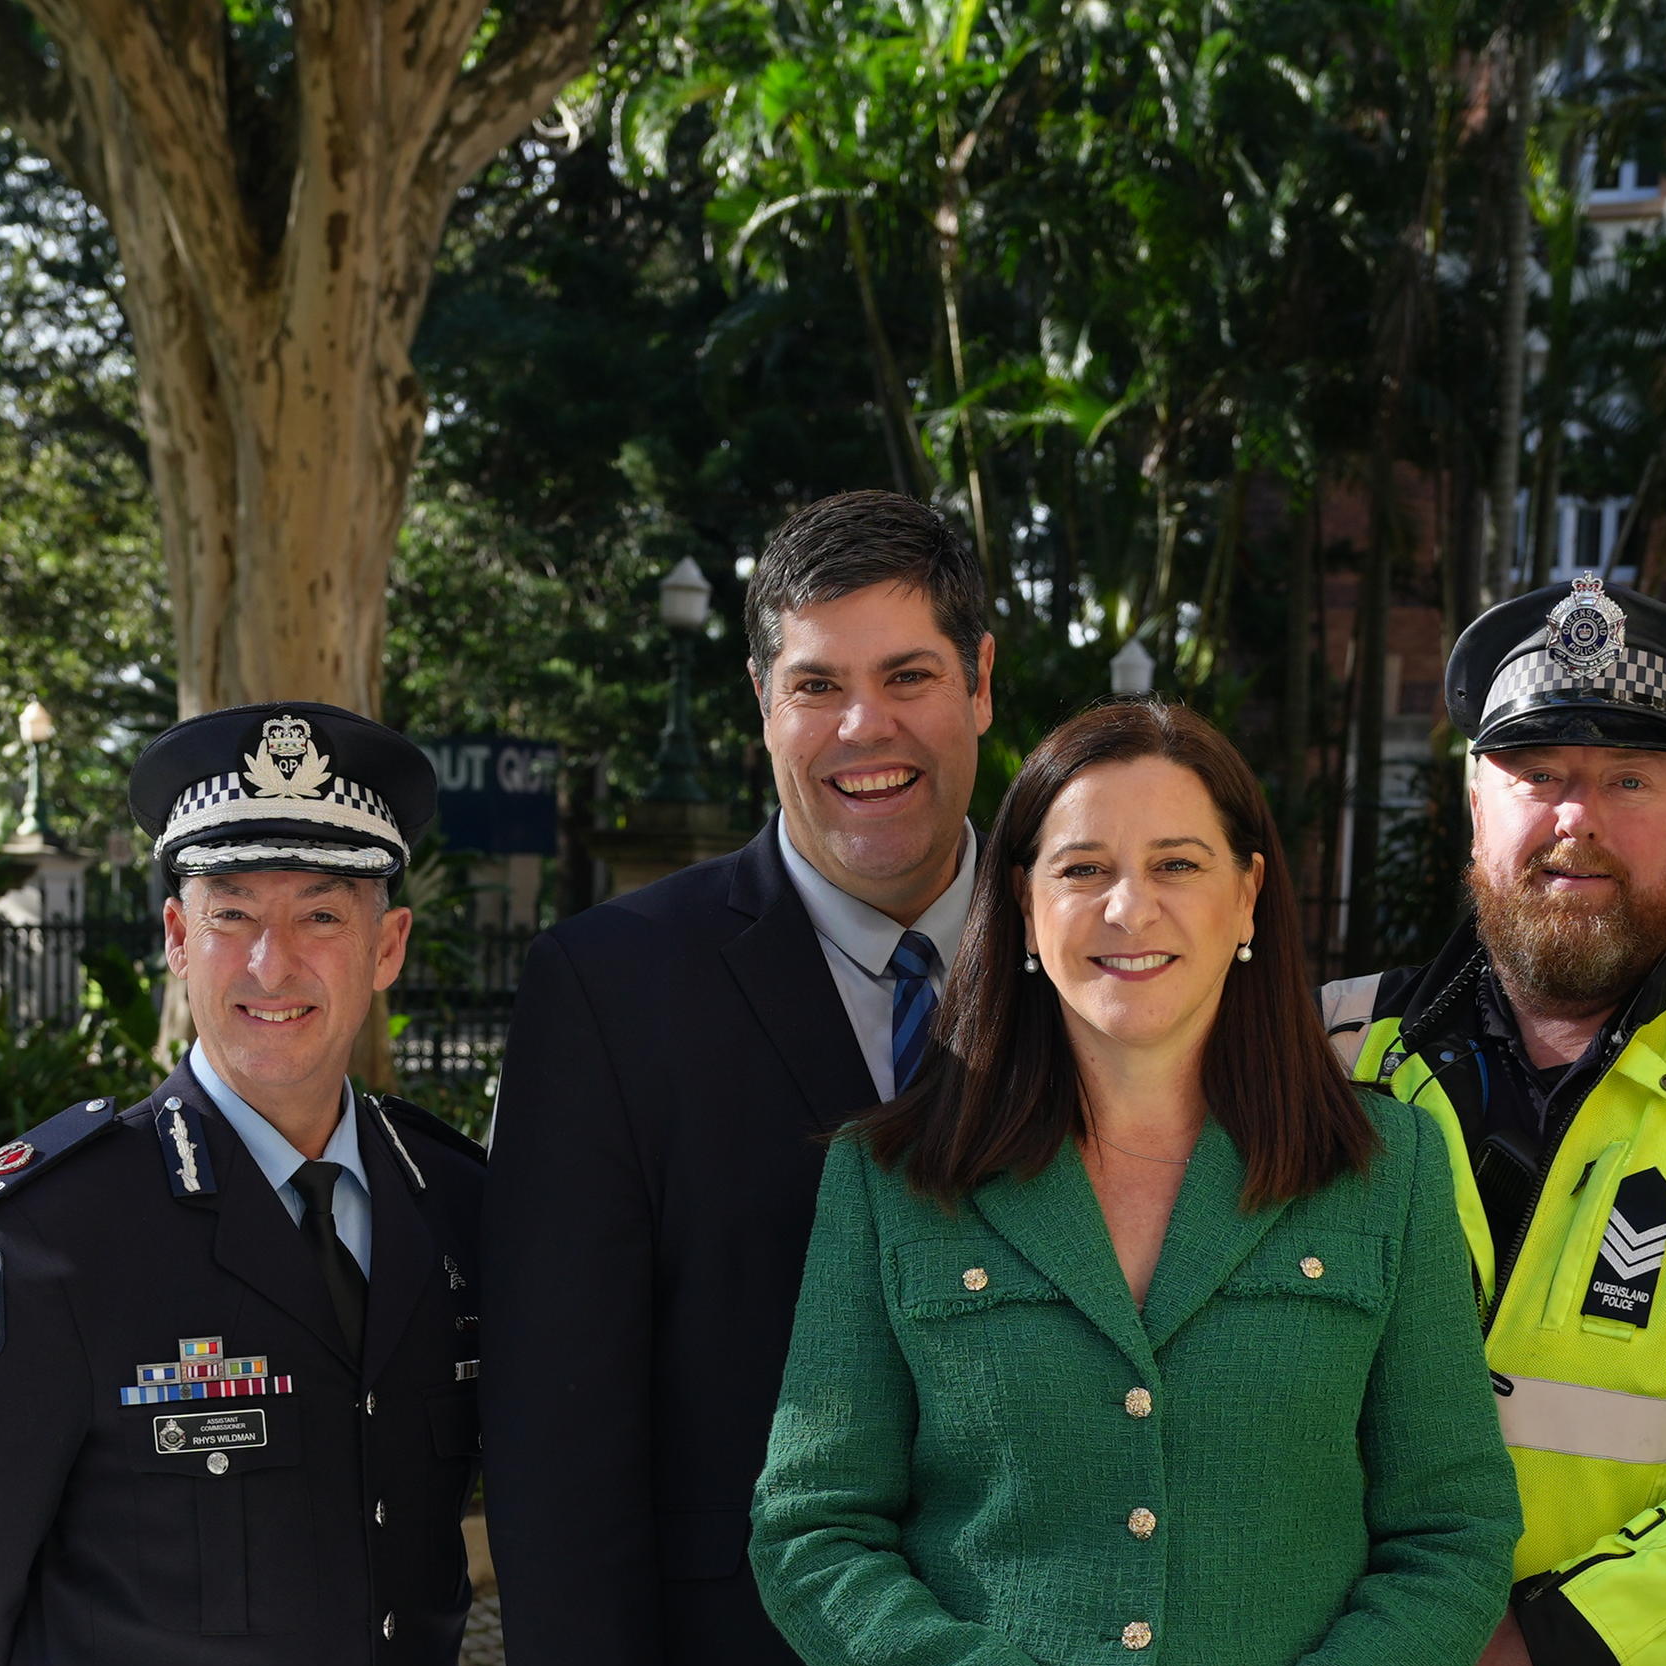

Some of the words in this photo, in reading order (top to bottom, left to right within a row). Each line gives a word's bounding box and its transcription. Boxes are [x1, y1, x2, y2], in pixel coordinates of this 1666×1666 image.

[1562, 608, 1607, 636] QUEENSLAND
[1567, 642, 1600, 656] POLICE
[279, 759, 298, 773] QP
[1593, 1281, 1649, 1303] QUEENSLAND
[1601, 1295, 1635, 1311] POLICE
[200, 1423, 246, 1432] COMMISSIONER
[206, 1416, 239, 1425] ASSISTANT
[193, 1436, 216, 1445] RHYS
[217, 1432, 256, 1443] WILDMAN
